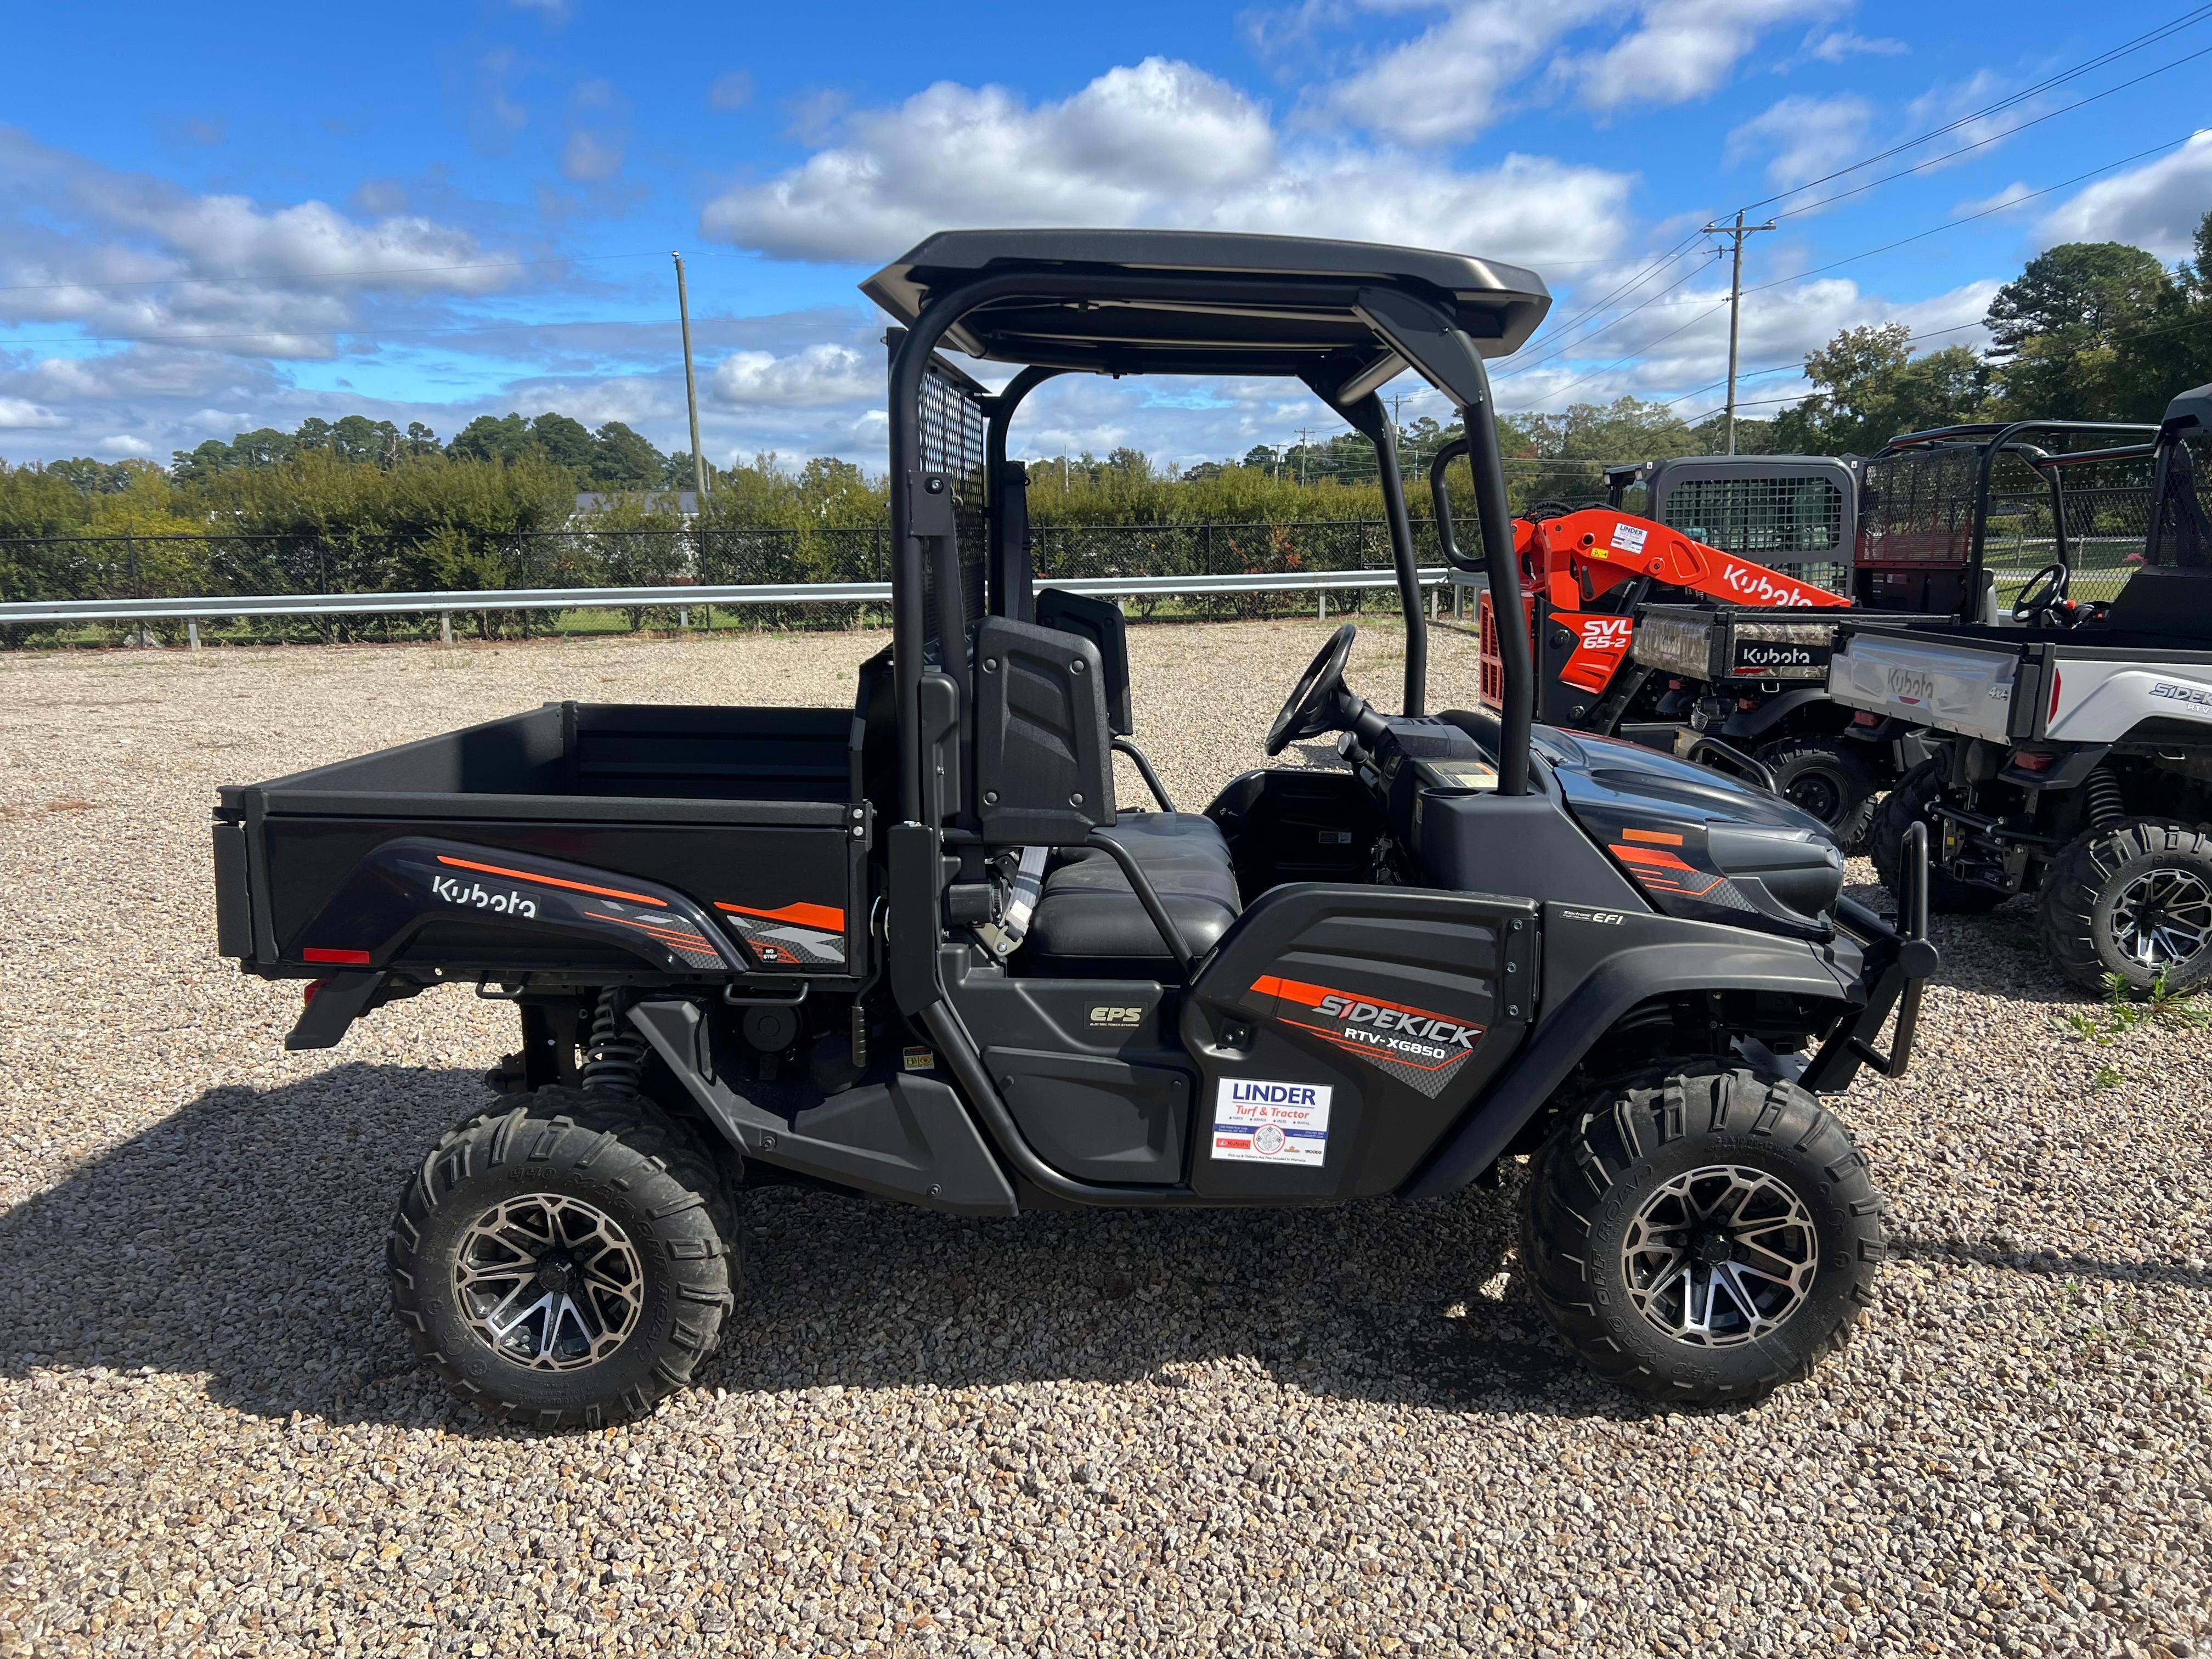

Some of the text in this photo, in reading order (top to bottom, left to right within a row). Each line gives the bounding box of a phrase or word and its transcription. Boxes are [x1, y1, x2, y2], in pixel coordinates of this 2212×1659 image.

[1620, 525, 1643, 535] LINDER
[1581, 619, 1632, 636] SVL
[1583, 636, 1626, 649] 65-2
[1743, 648, 1810, 663] Kubota
[1888, 668, 1933, 698] Kubota
[432, 876, 536, 918] Kubota
[1592, 913, 1623, 924] EFI
[1090, 1007, 1142, 1022] EPS
[1311, 994, 1482, 1049] SIDEKICK
[1344, 1027, 1445, 1059] RTV-XG850
[1233, 1084, 1316, 1105] LINDER
[1236, 1105, 1258, 1117] Turf
[1271, 1108, 1309, 1119] Tractor
